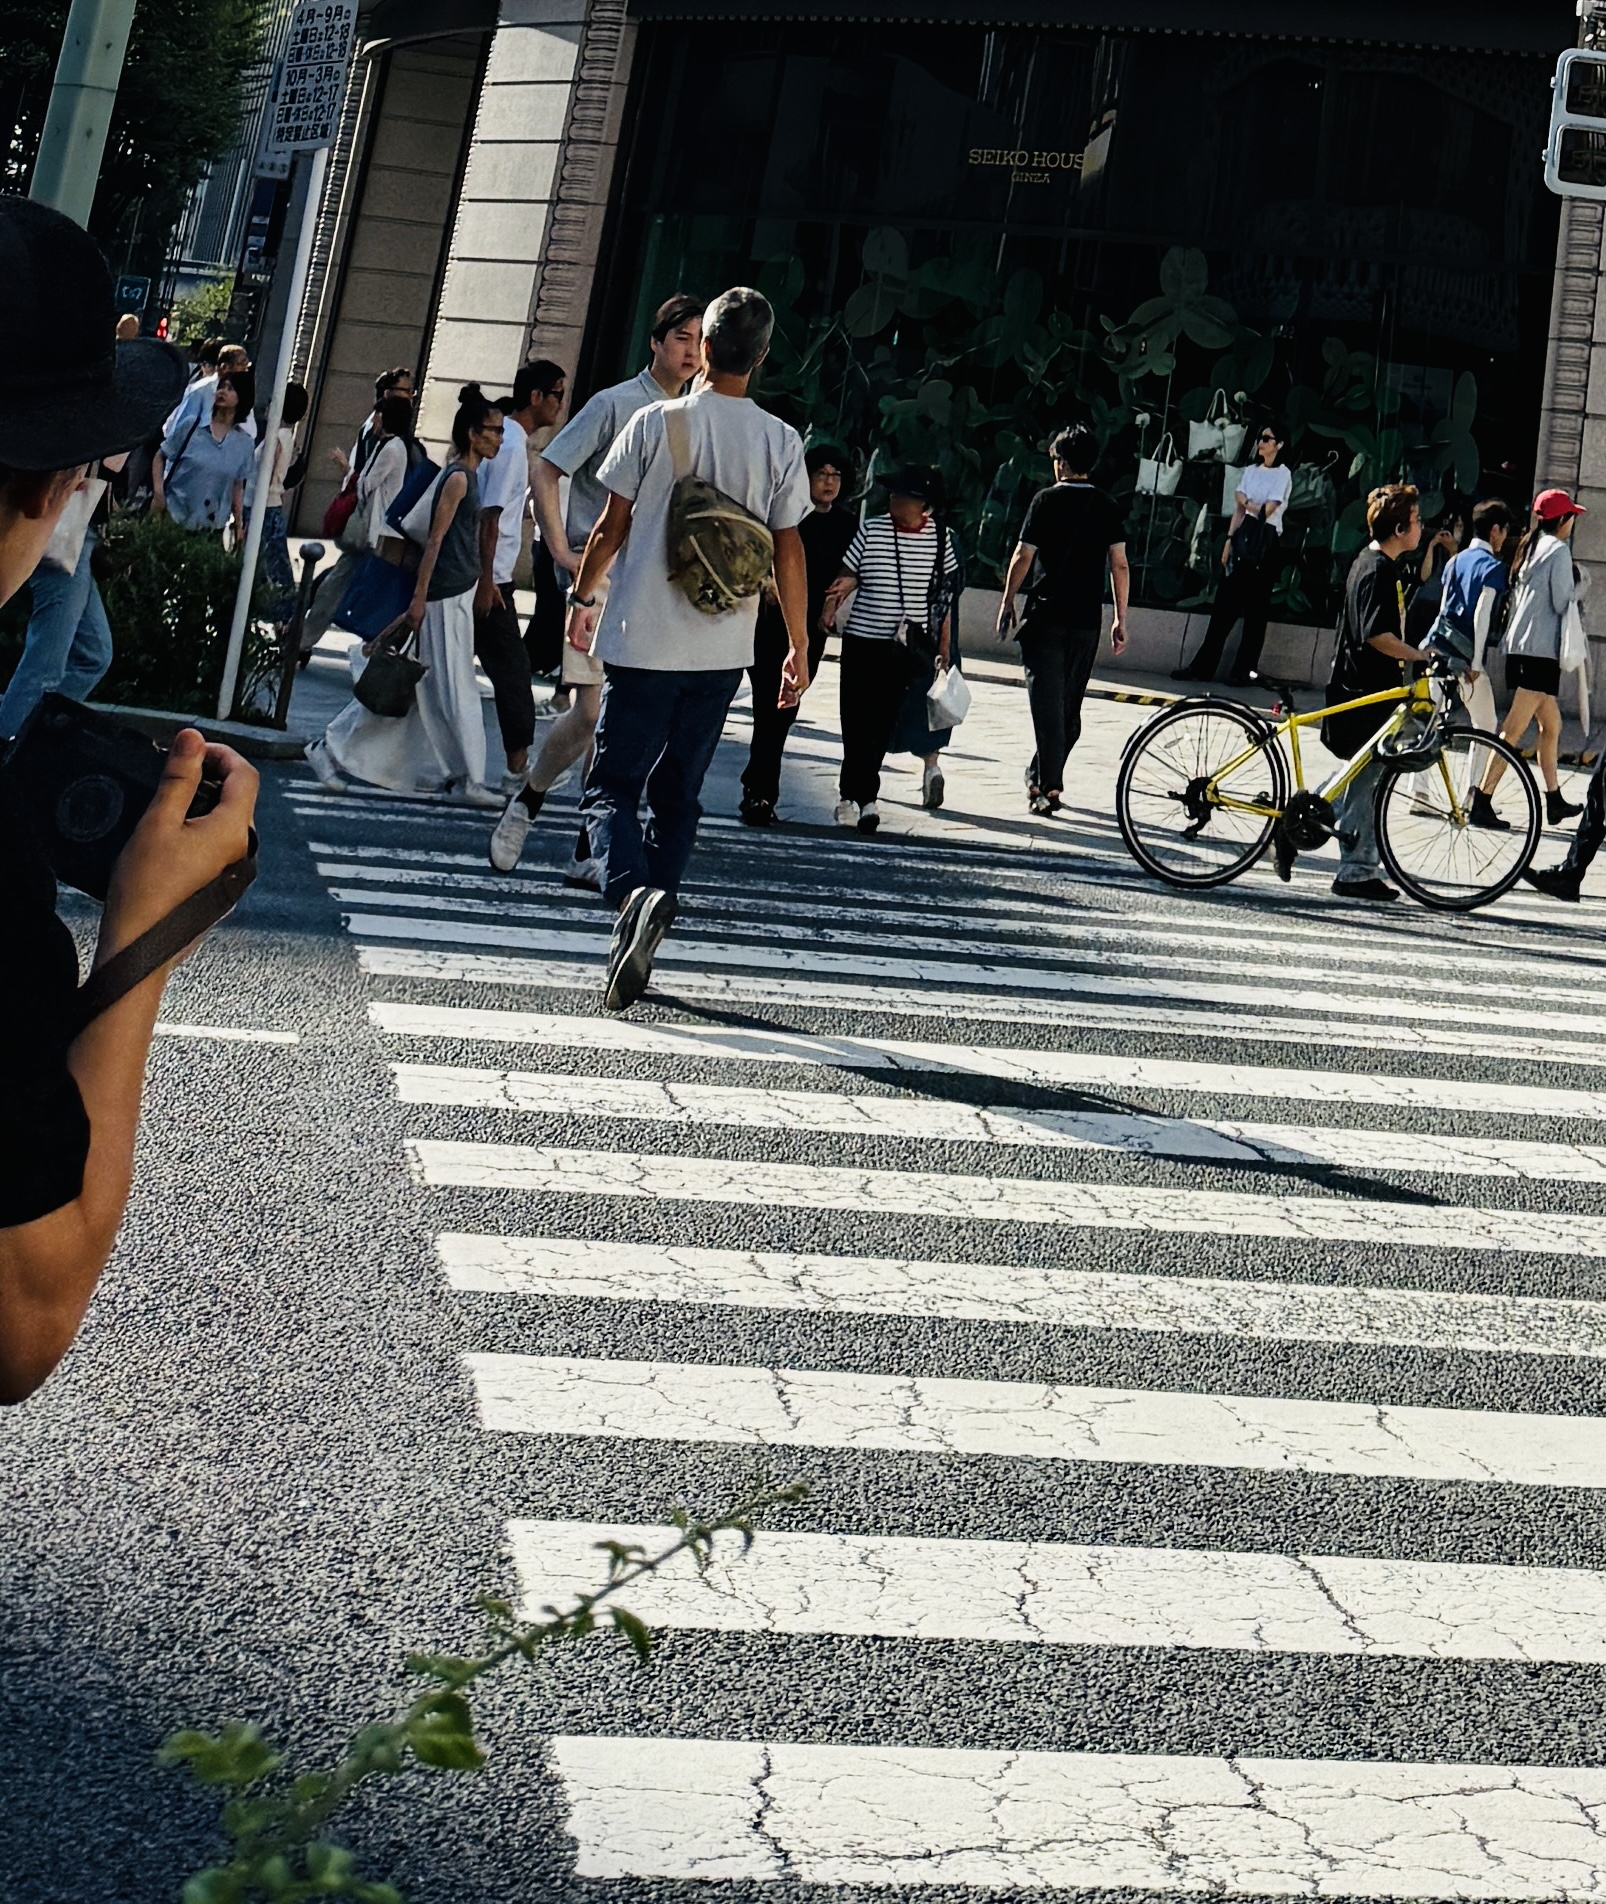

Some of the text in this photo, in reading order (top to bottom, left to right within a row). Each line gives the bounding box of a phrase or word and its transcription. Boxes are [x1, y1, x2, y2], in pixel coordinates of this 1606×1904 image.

[968, 149, 1085, 170] SEIKO HOUS
[1011, 172, 1050, 184] GINZA
